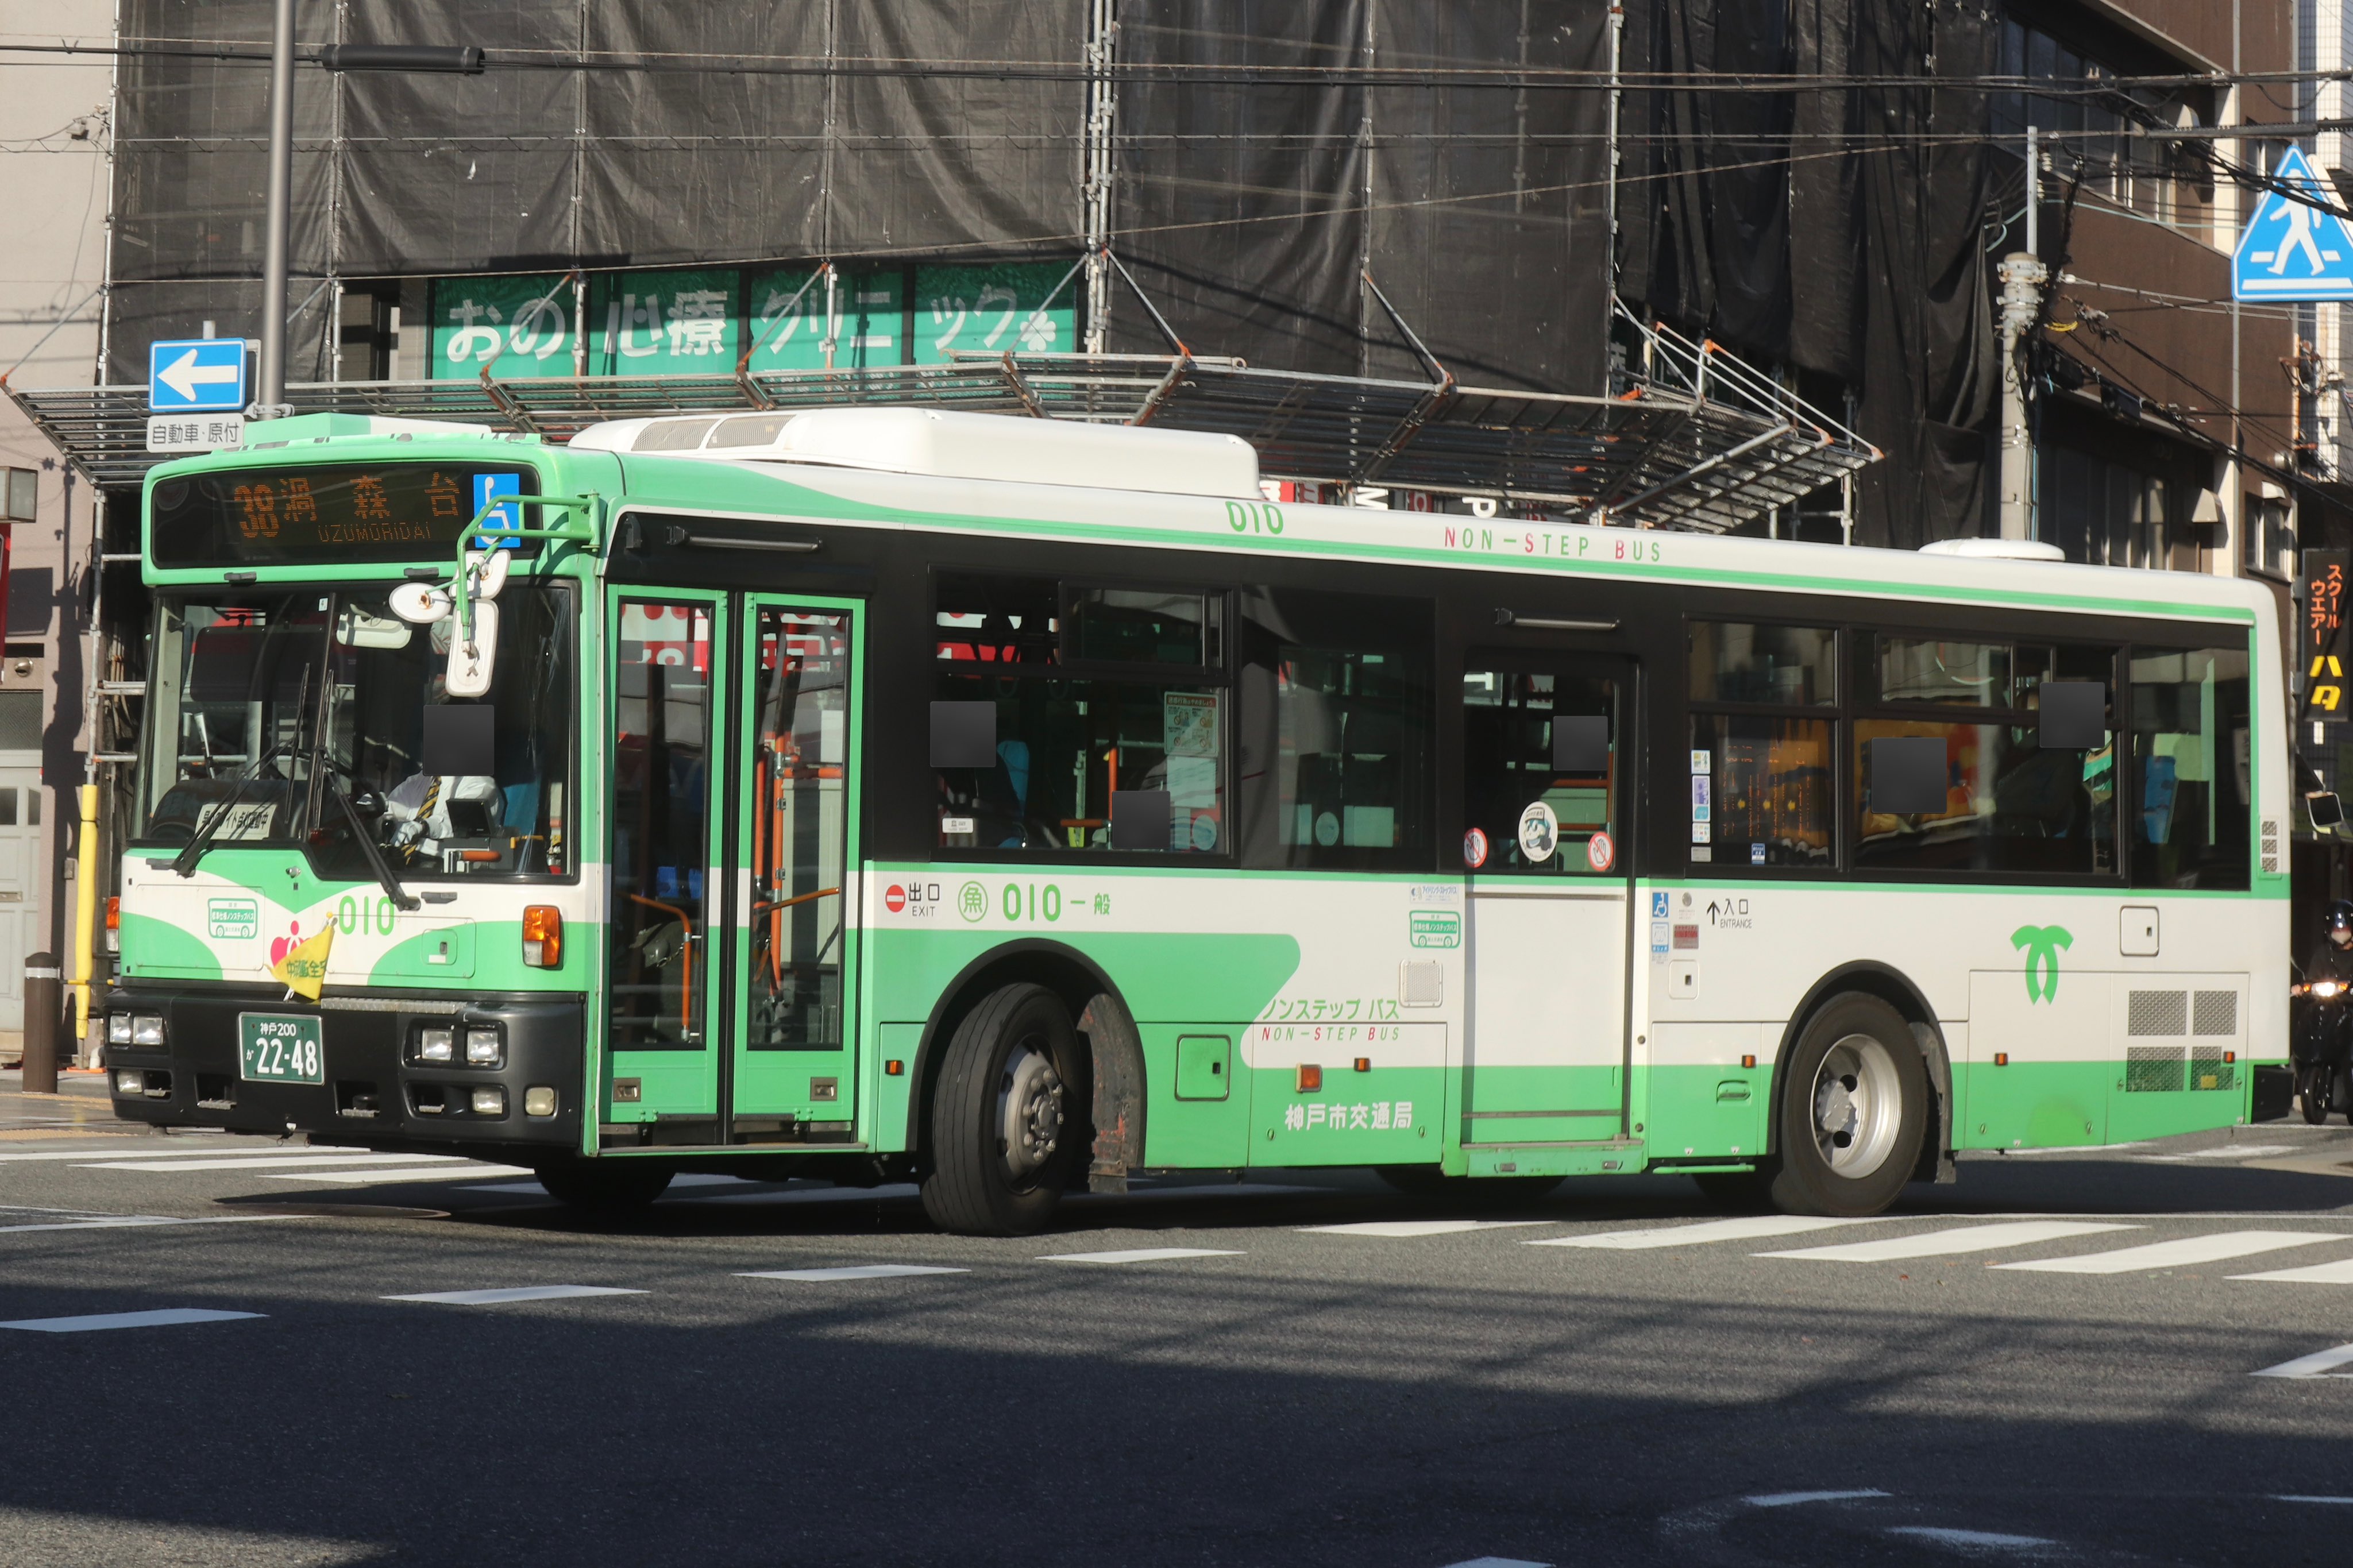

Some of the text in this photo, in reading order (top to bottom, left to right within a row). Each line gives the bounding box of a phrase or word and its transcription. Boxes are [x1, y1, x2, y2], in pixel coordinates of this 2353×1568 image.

[1225, 500, 1284, 534] 010
[317, 522, 431, 542] UZUMORIDAI
[1615, 540, 1661, 562] BUS
[2327, 565, 2342, 629] スクール
[2308, 655, 2343, 711] ハタ
[909, 882, 940, 902] 出口
[339, 895, 395, 936] 010
[912, 906, 935, 917] EXIT
[1723, 898, 1749, 915] 入口
[1720, 918, 1752, 929] ENTRANCE
[1368, 1026, 1400, 1041] BUS
[256, 1037, 318, 1077] 22-48
[1285, 1102, 1413, 1130] 神戸市交通局
